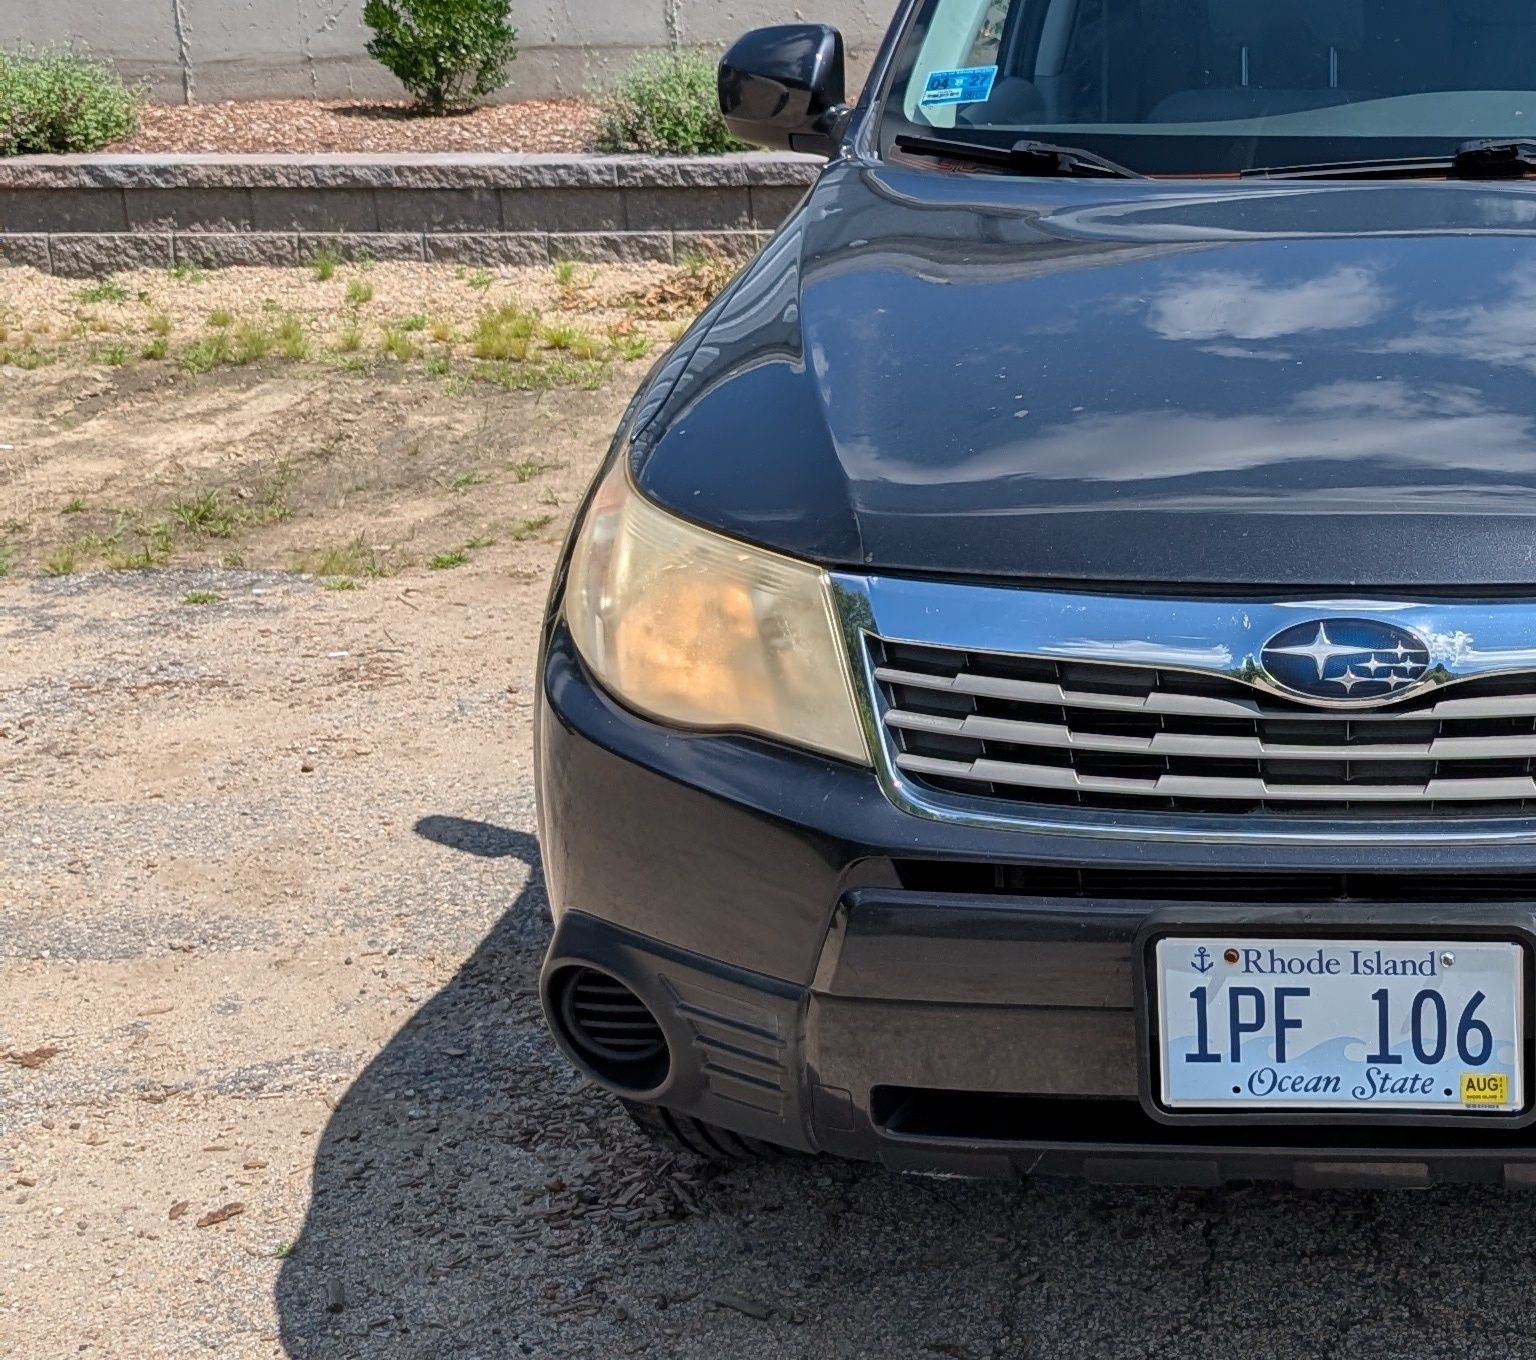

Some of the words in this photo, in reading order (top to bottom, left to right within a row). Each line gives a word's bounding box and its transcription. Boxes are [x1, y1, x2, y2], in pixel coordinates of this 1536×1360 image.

[931, 78, 950, 90] 04
[970, 74, 988, 87] 27
[1241, 947, 1341, 975] Rhode
[1351, 950, 1438, 977] Island
[1185, 986, 1311, 1064] 1PF
[1366, 987, 1493, 1067] 106
[1247, 1067, 1341, 1097] Ocean
[1352, 1067, 1435, 1101] State
[1465, 1077, 1499, 1092] AUG
